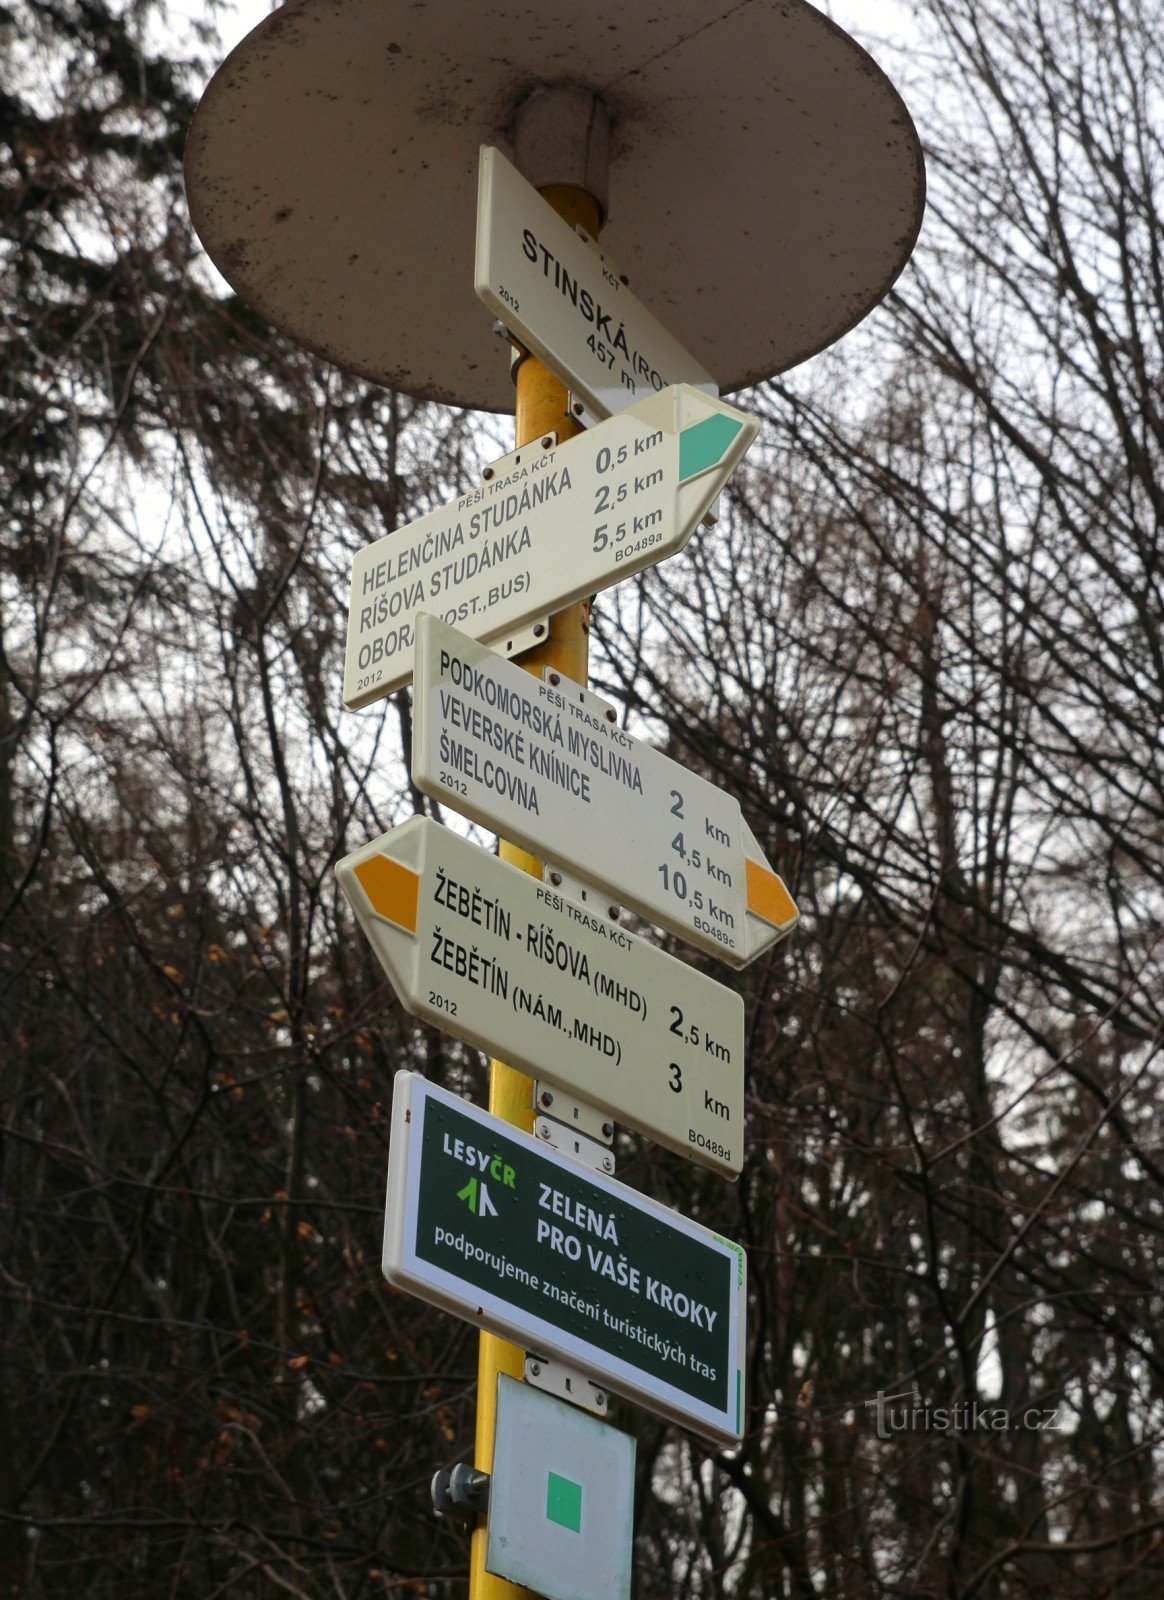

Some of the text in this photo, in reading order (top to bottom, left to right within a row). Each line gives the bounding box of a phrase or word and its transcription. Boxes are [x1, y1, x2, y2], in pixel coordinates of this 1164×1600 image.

[499, 285, 520, 313] 2012
[522, 229, 669, 392] STINSKÁ (RO
[602, 266, 620, 291] KČT
[586, 334, 635, 395] 457 m
[362, 430, 663, 596] HELENČINA STUDÁNKA 0,5 km
[458, 452, 556, 512] PĚŠÍ TRASA KČT
[360, 468, 664, 634] RÍŠOVA STUDÁNKA 2,5 km
[615, 532, 662, 563] BO489a
[357, 508, 663, 670] OBOR OST.,BUS) 5,5 km
[356, 670, 383, 691] 2012
[441, 649, 731, 848] PODKOMORSKÁ MYSLIVNA 2 km
[539, 685, 634, 751] PĚŠÍ TRASA KČT
[439, 771, 468, 797] 2012
[440, 689, 732, 888] VEVERSKÉ KNÍNICE 4,5 km
[440, 726, 734, 929] ŠMELCOVNA 10,5 km
[536, 887, 634, 951] PĚŠÍ TRASA KČT
[693, 915, 735, 949] BO489c
[434, 866, 511, 942] ŽEBĚTÍN
[526, 922, 591, 986] RÍŠOVA
[593, 971, 648, 1022] (MHD)
[669, 1005, 699, 1046] 2,5
[705, 1032, 731, 1065] km
[428, 991, 458, 1017] 2012
[430, 924, 730, 1121] ŽEBĚTÍN (NÁM.,MHD) 3 km
[688, 1128, 731, 1162] BO489d
[538, 1182, 619, 1246] ZELENÁ
[434, 1226, 717, 1382] podporujeme značení turistických tras
[537, 1218, 718, 1333] PRO VAŠE KROKY
